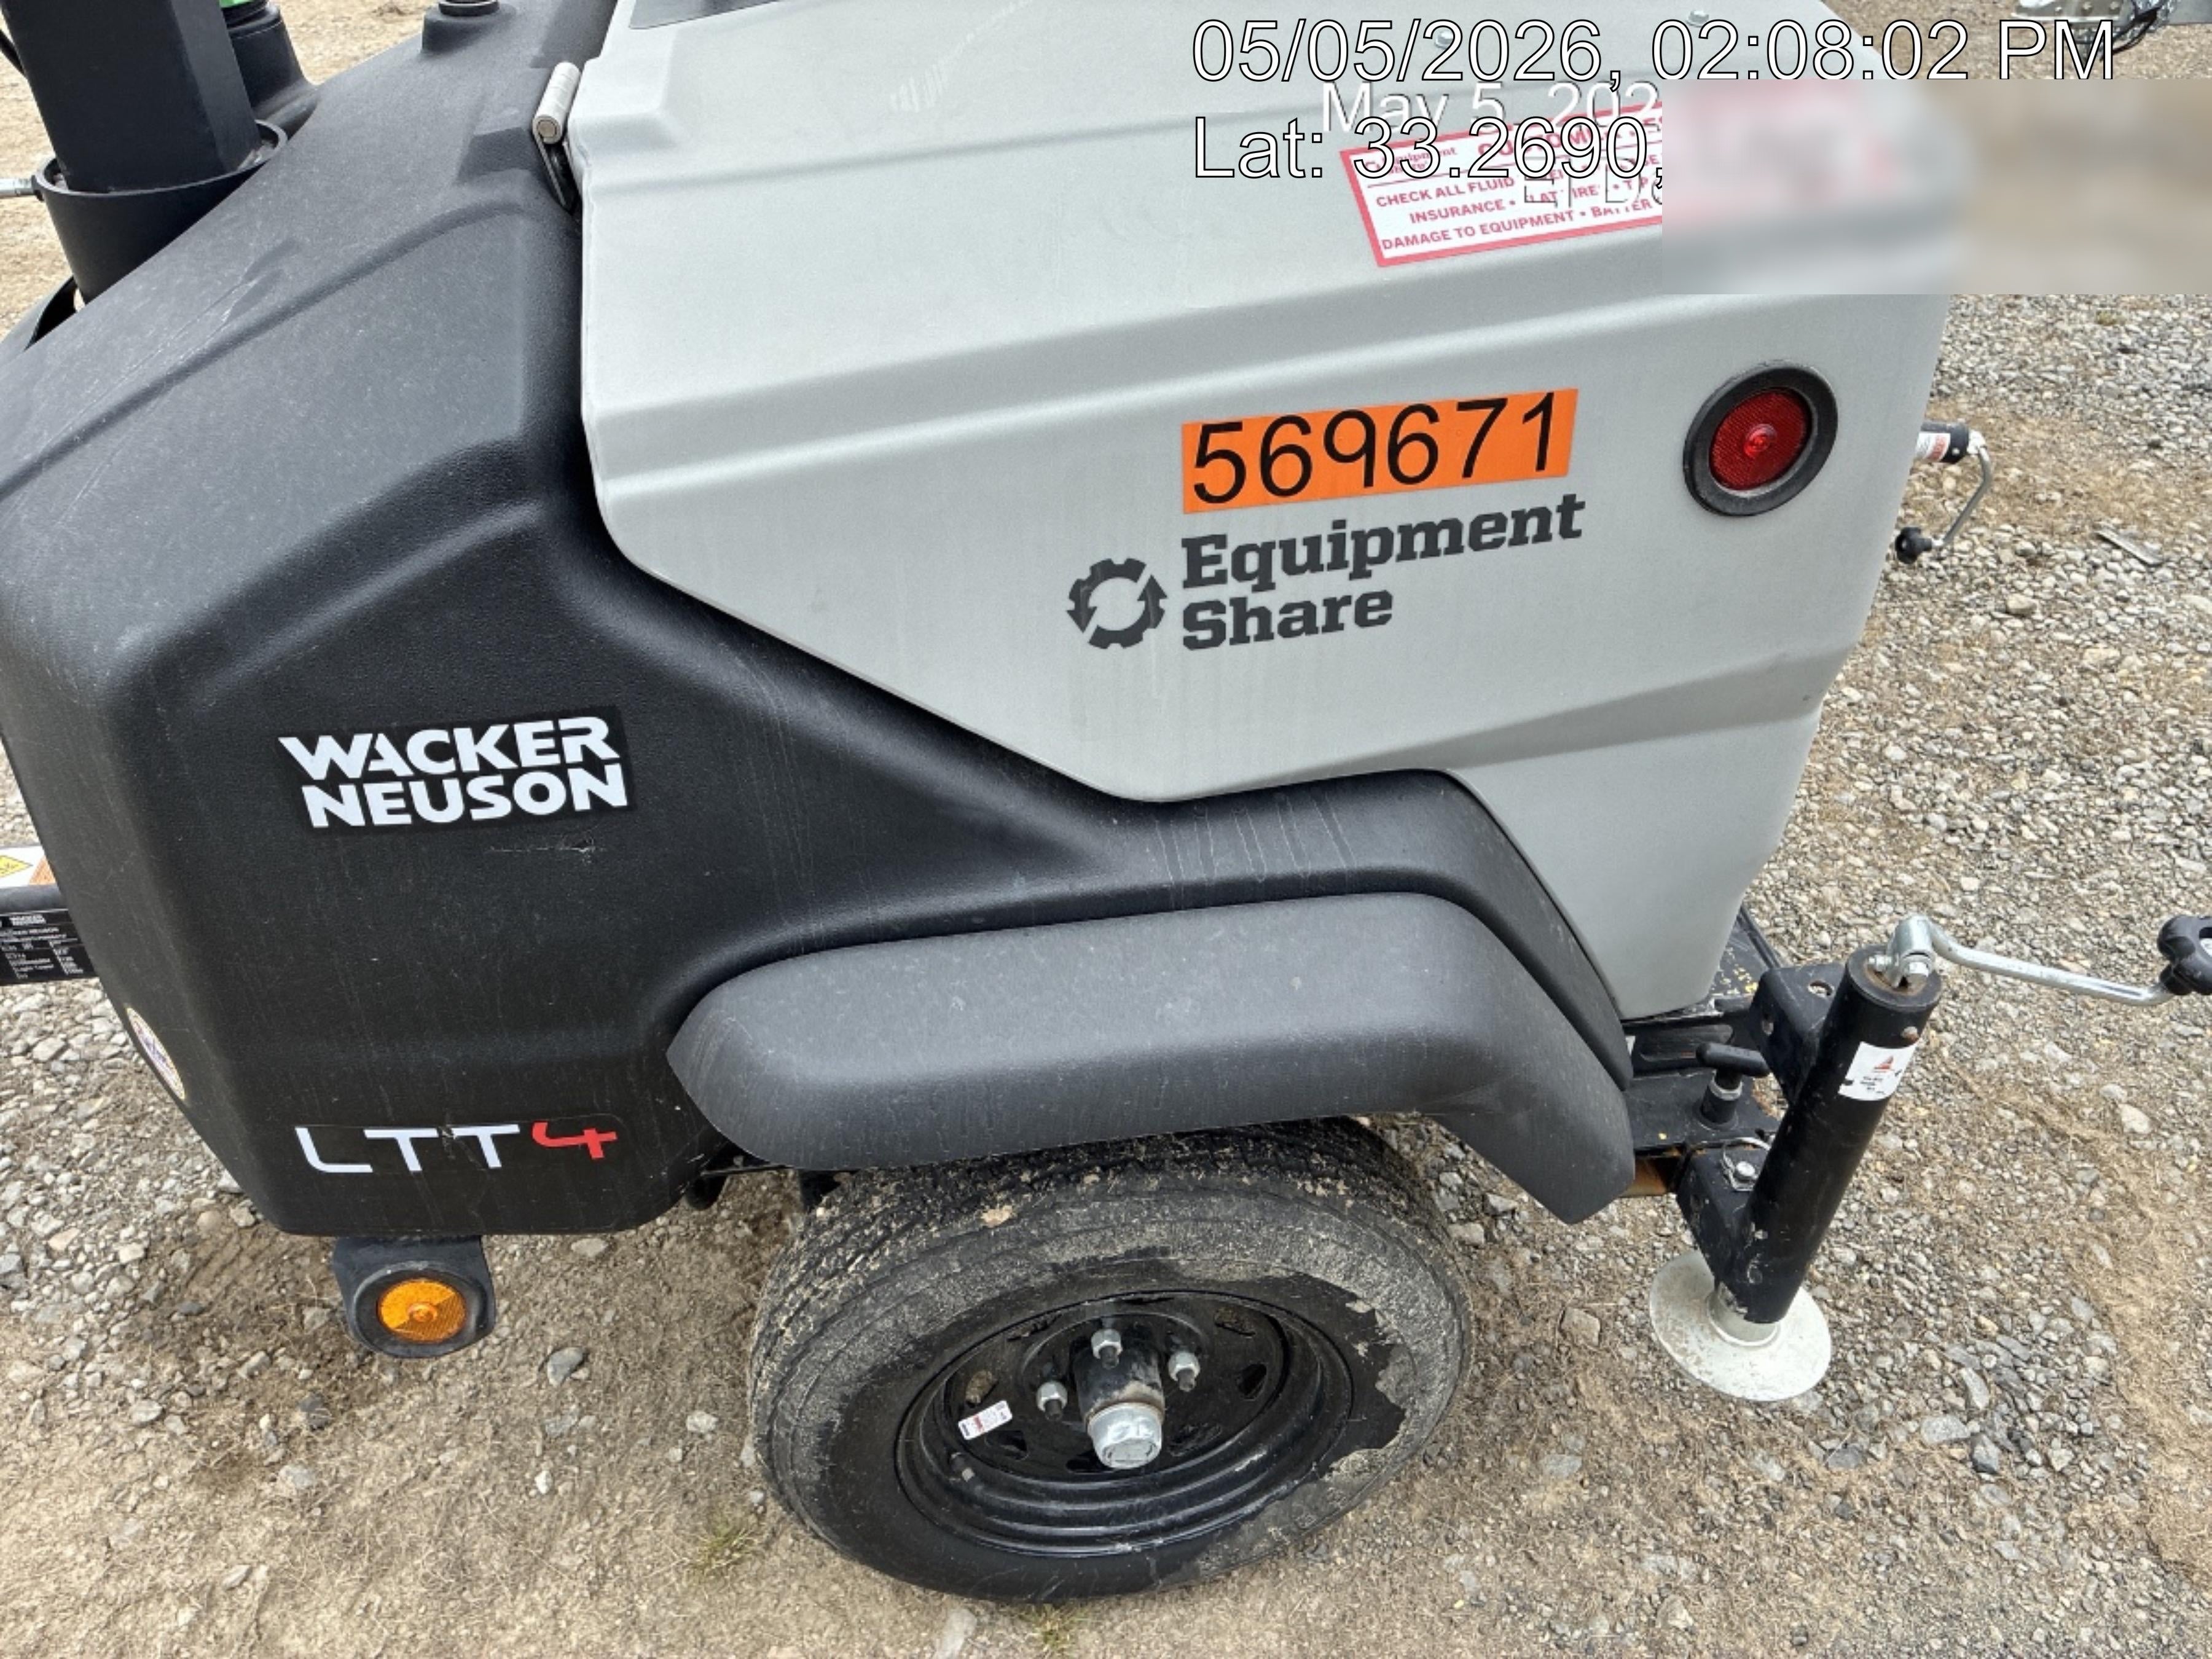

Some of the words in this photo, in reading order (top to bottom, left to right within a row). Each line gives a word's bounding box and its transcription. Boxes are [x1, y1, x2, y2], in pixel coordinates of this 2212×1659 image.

[1376, 189, 1433, 208] CHECK
[1435, 185, 1465, 198] ALL
[1409, 198, 1506, 224] INSURANCE
[1381, 229, 1451, 249] DAMAGE
[1453, 226, 1475, 238] TO
[1479, 209, 1575, 234] EQUIPMENT
[1192, 391, 1555, 505] 569671
[1181, 493, 1586, 593] Equipment
[1182, 589, 1394, 651] Share
[278, 716, 620, 781] WACKER
[302, 763, 628, 828] NEUSON
